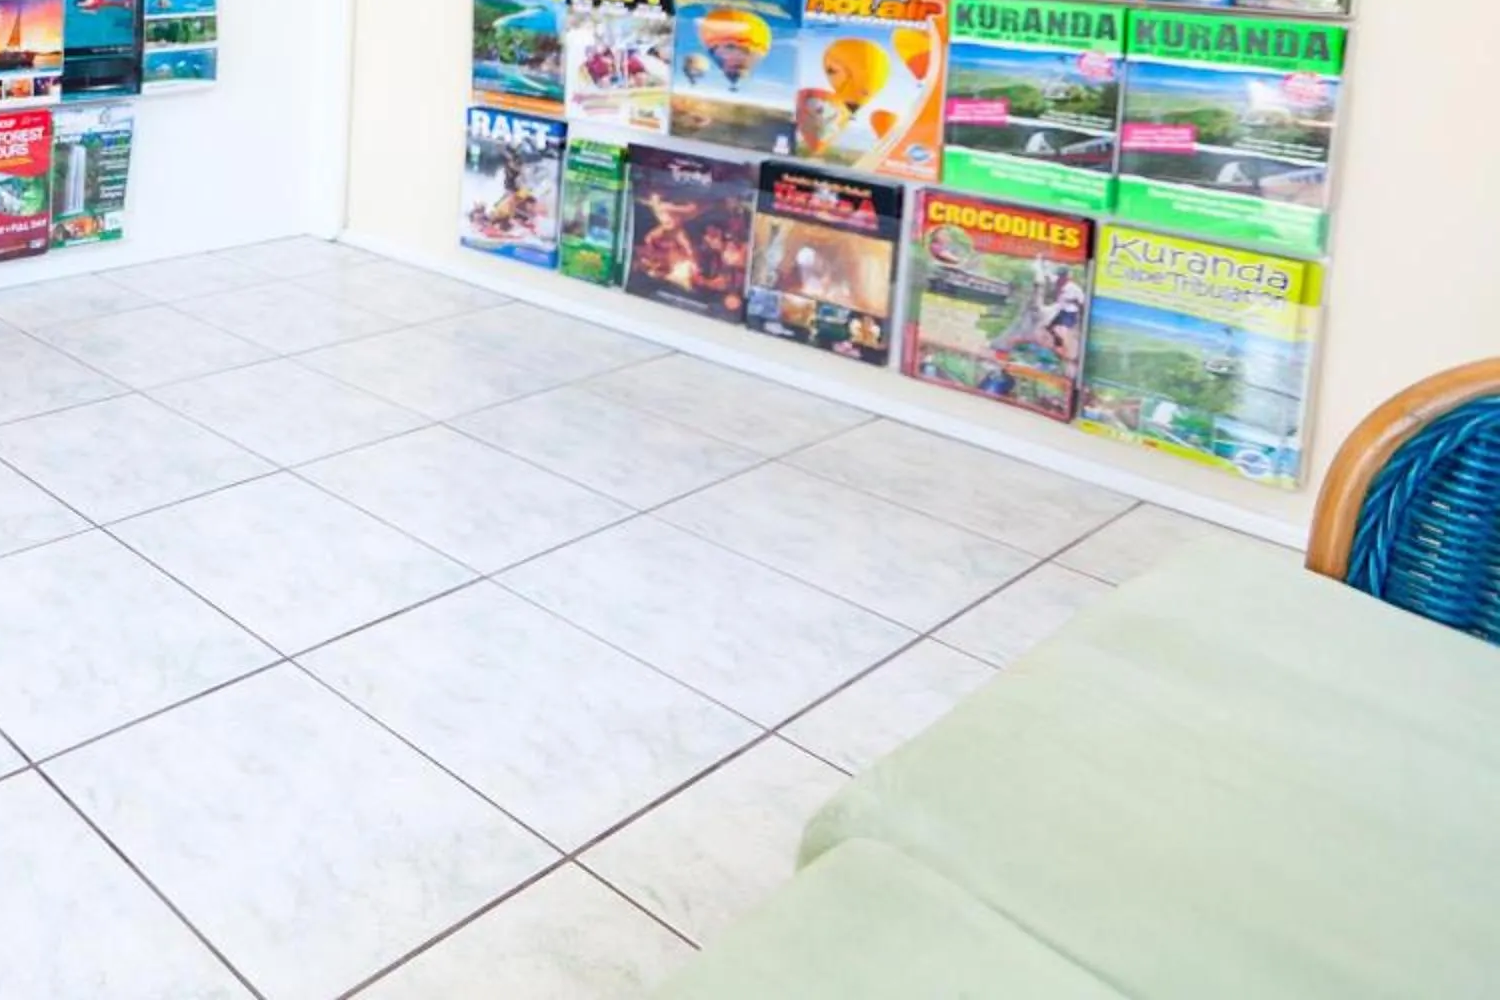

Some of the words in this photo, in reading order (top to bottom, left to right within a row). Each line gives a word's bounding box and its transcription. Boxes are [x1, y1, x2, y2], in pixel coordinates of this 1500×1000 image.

[955, 2, 1117, 41] KURANDA
[1136, 18, 1330, 61] KURANDA
[471, 110, 551, 148] RAFT
[929, 200, 1080, 248] CROCODILES
[1110, 235, 1288, 291] Kuranda
